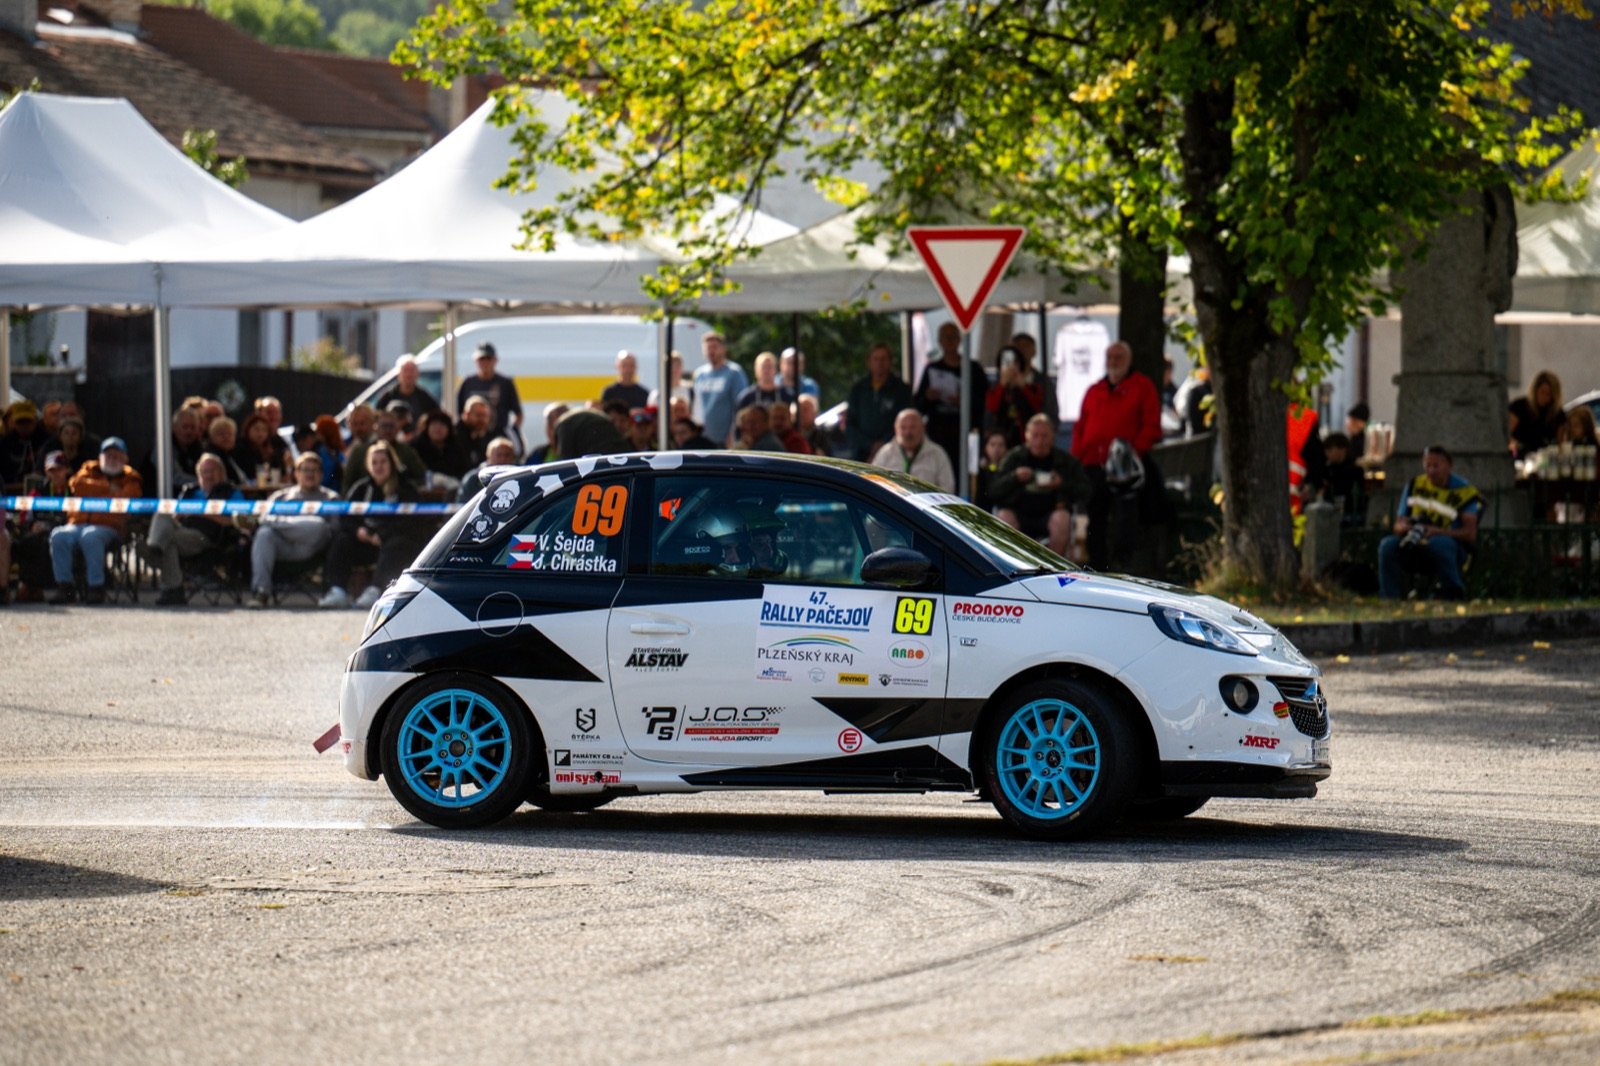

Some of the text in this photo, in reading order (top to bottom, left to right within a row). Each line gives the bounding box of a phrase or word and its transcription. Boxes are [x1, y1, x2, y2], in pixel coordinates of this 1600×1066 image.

[571, 484, 628, 537] 69
[538, 531, 595, 553] V. Šejda
[533, 553, 617, 573] J. Chrástka
[809, 591, 829, 606] 47.
[760, 601, 873, 627] RALLY PAČEJOV
[895, 598, 933, 634] 69
[953, 602, 1024, 617] PRONOVO
[624, 653, 689, 667] ALSTAV
[758, 647, 854, 666] PLZEŇSKÝ KRAJ
[1243, 735, 1280, 749] MRF
